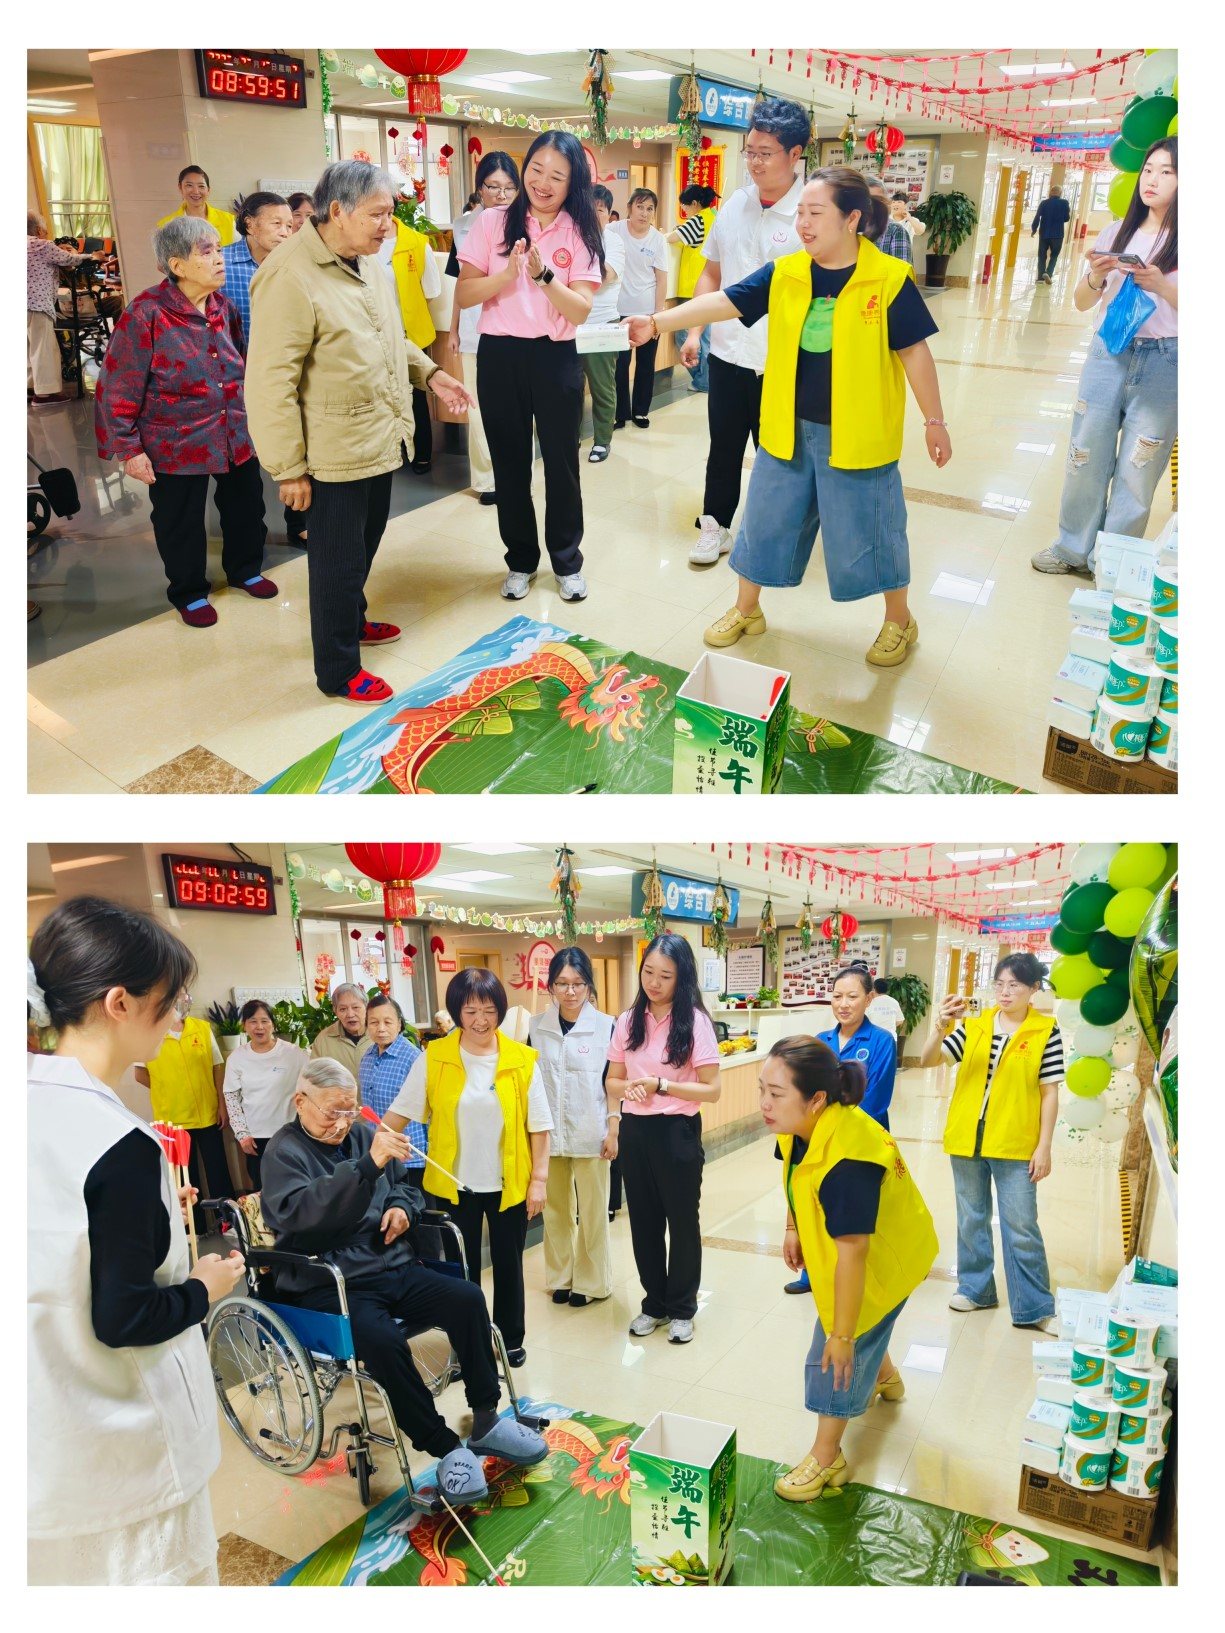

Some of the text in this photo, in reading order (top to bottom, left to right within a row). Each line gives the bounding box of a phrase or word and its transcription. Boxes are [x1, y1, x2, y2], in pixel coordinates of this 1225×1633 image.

[212, 71, 299, 99] 08:59:51
[718, 716, 758, 794] 端午
[181, 880, 267, 907] 09:02:59
[668, 1465, 704, 1539] 端午
